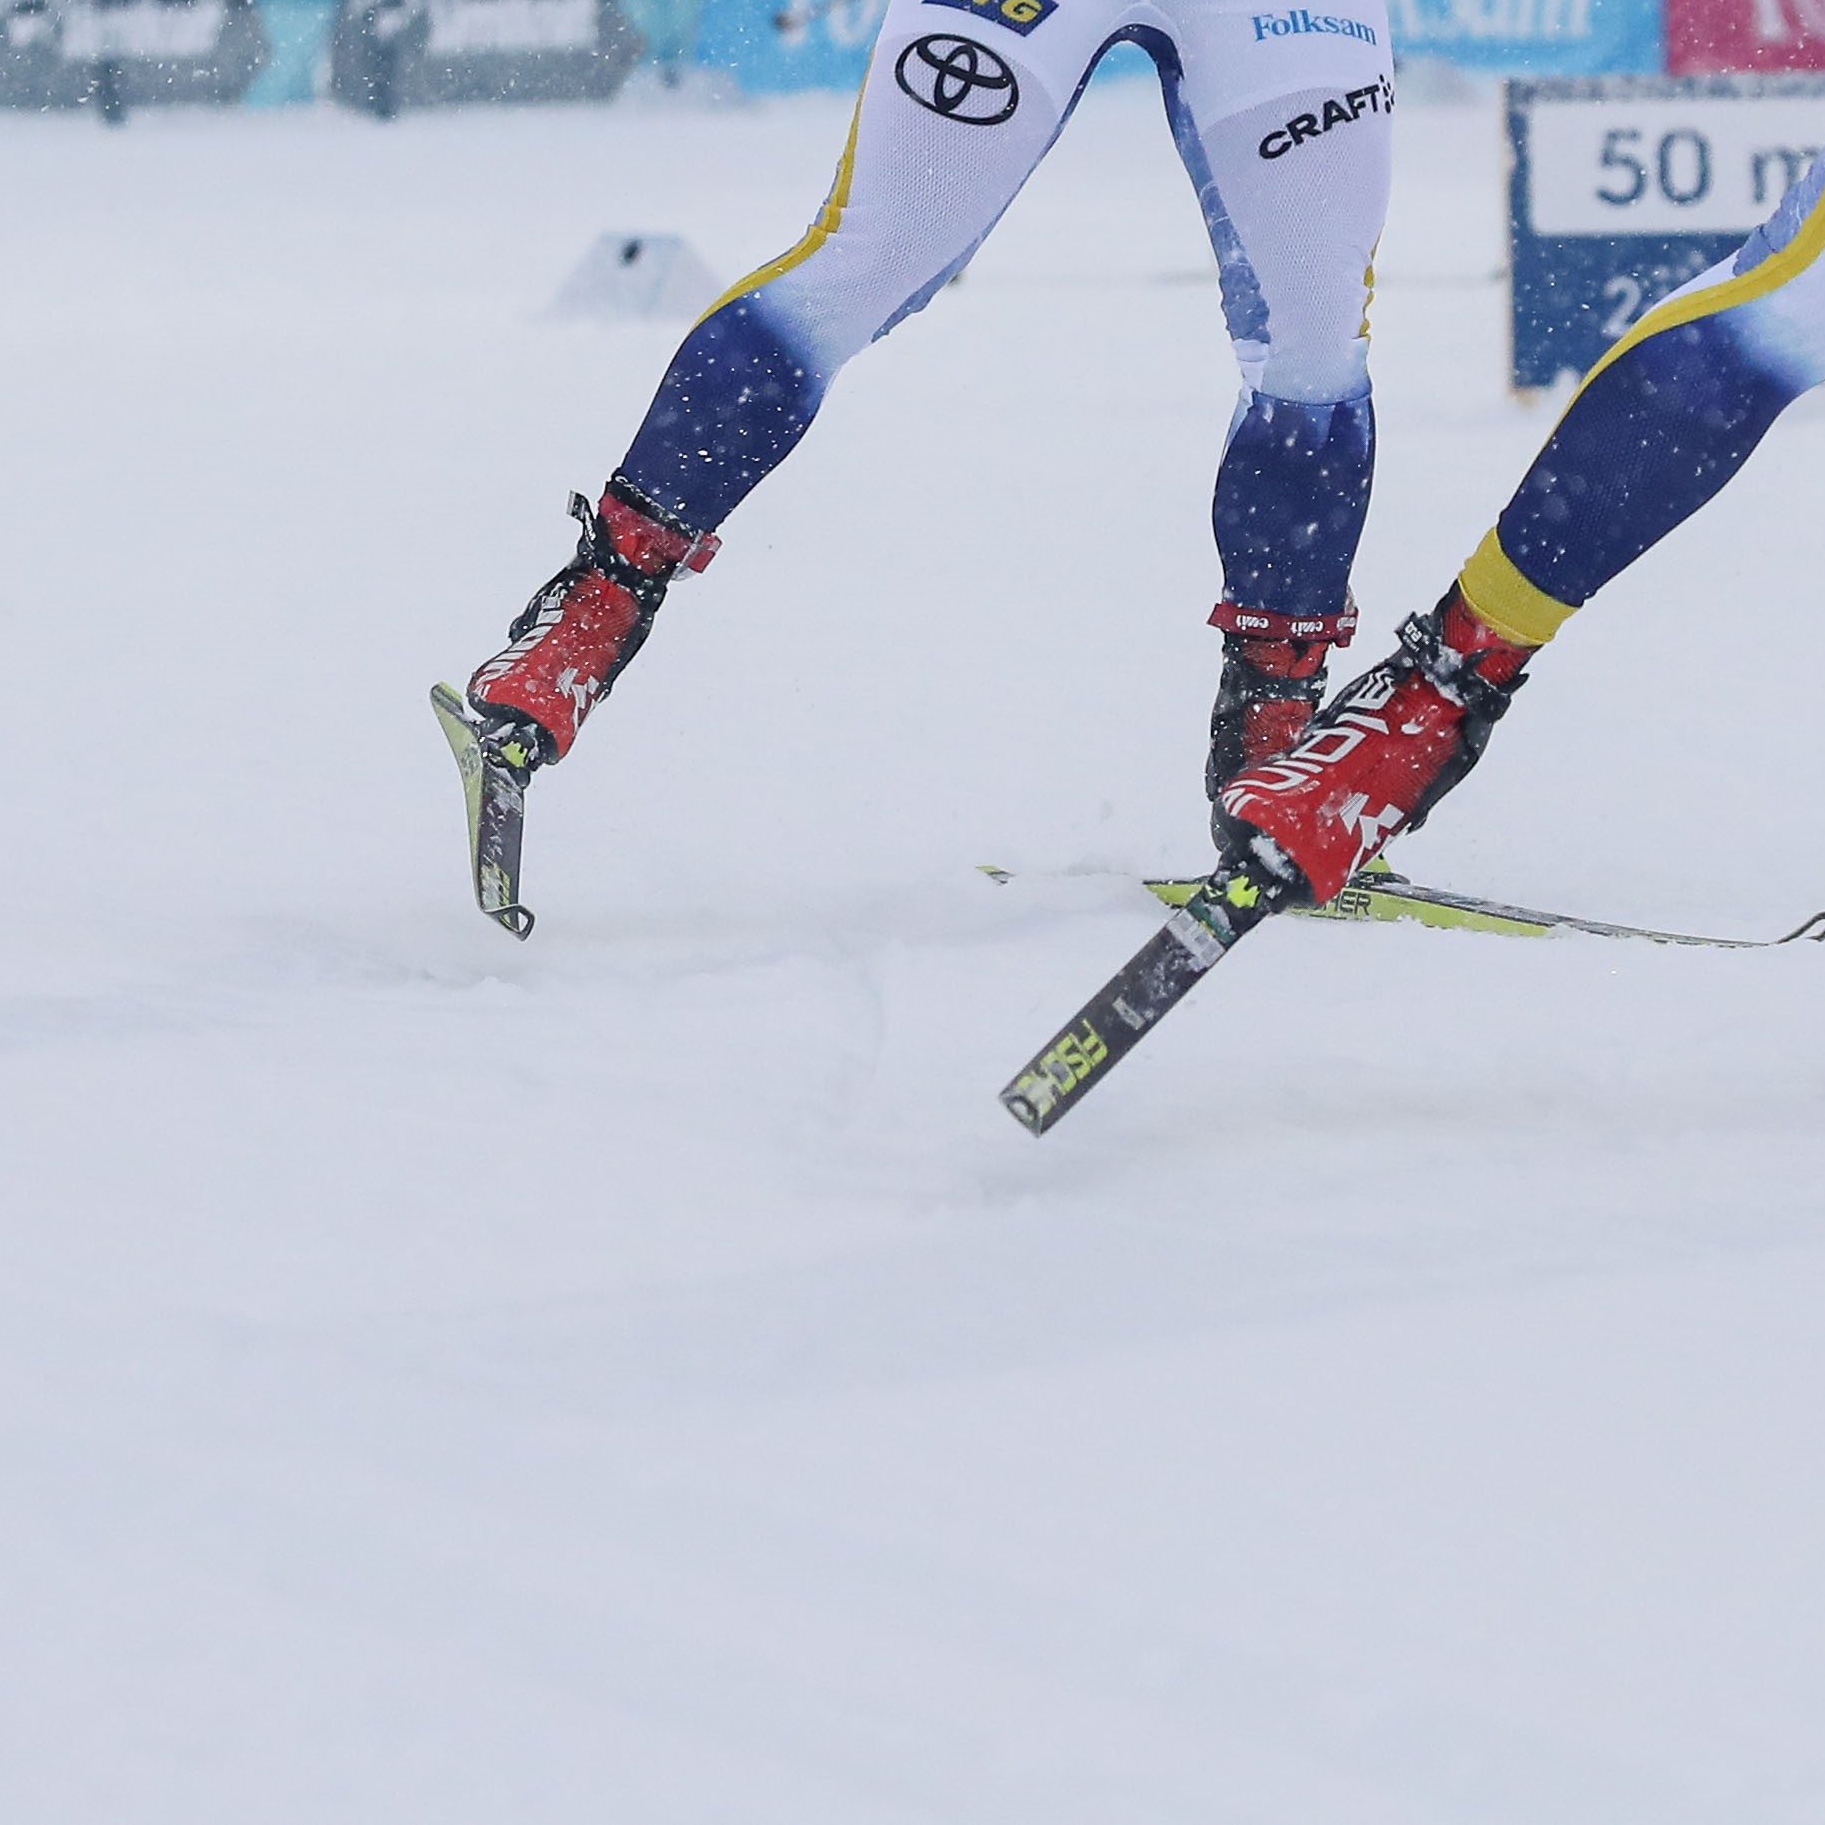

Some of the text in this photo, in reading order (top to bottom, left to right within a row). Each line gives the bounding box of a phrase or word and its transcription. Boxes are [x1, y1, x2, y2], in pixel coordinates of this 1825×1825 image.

[1253, 8, 1377, 46] Folksam
[1258, 84, 1384, 160] CRAFT
[1597, 128, 1711, 205] 50
